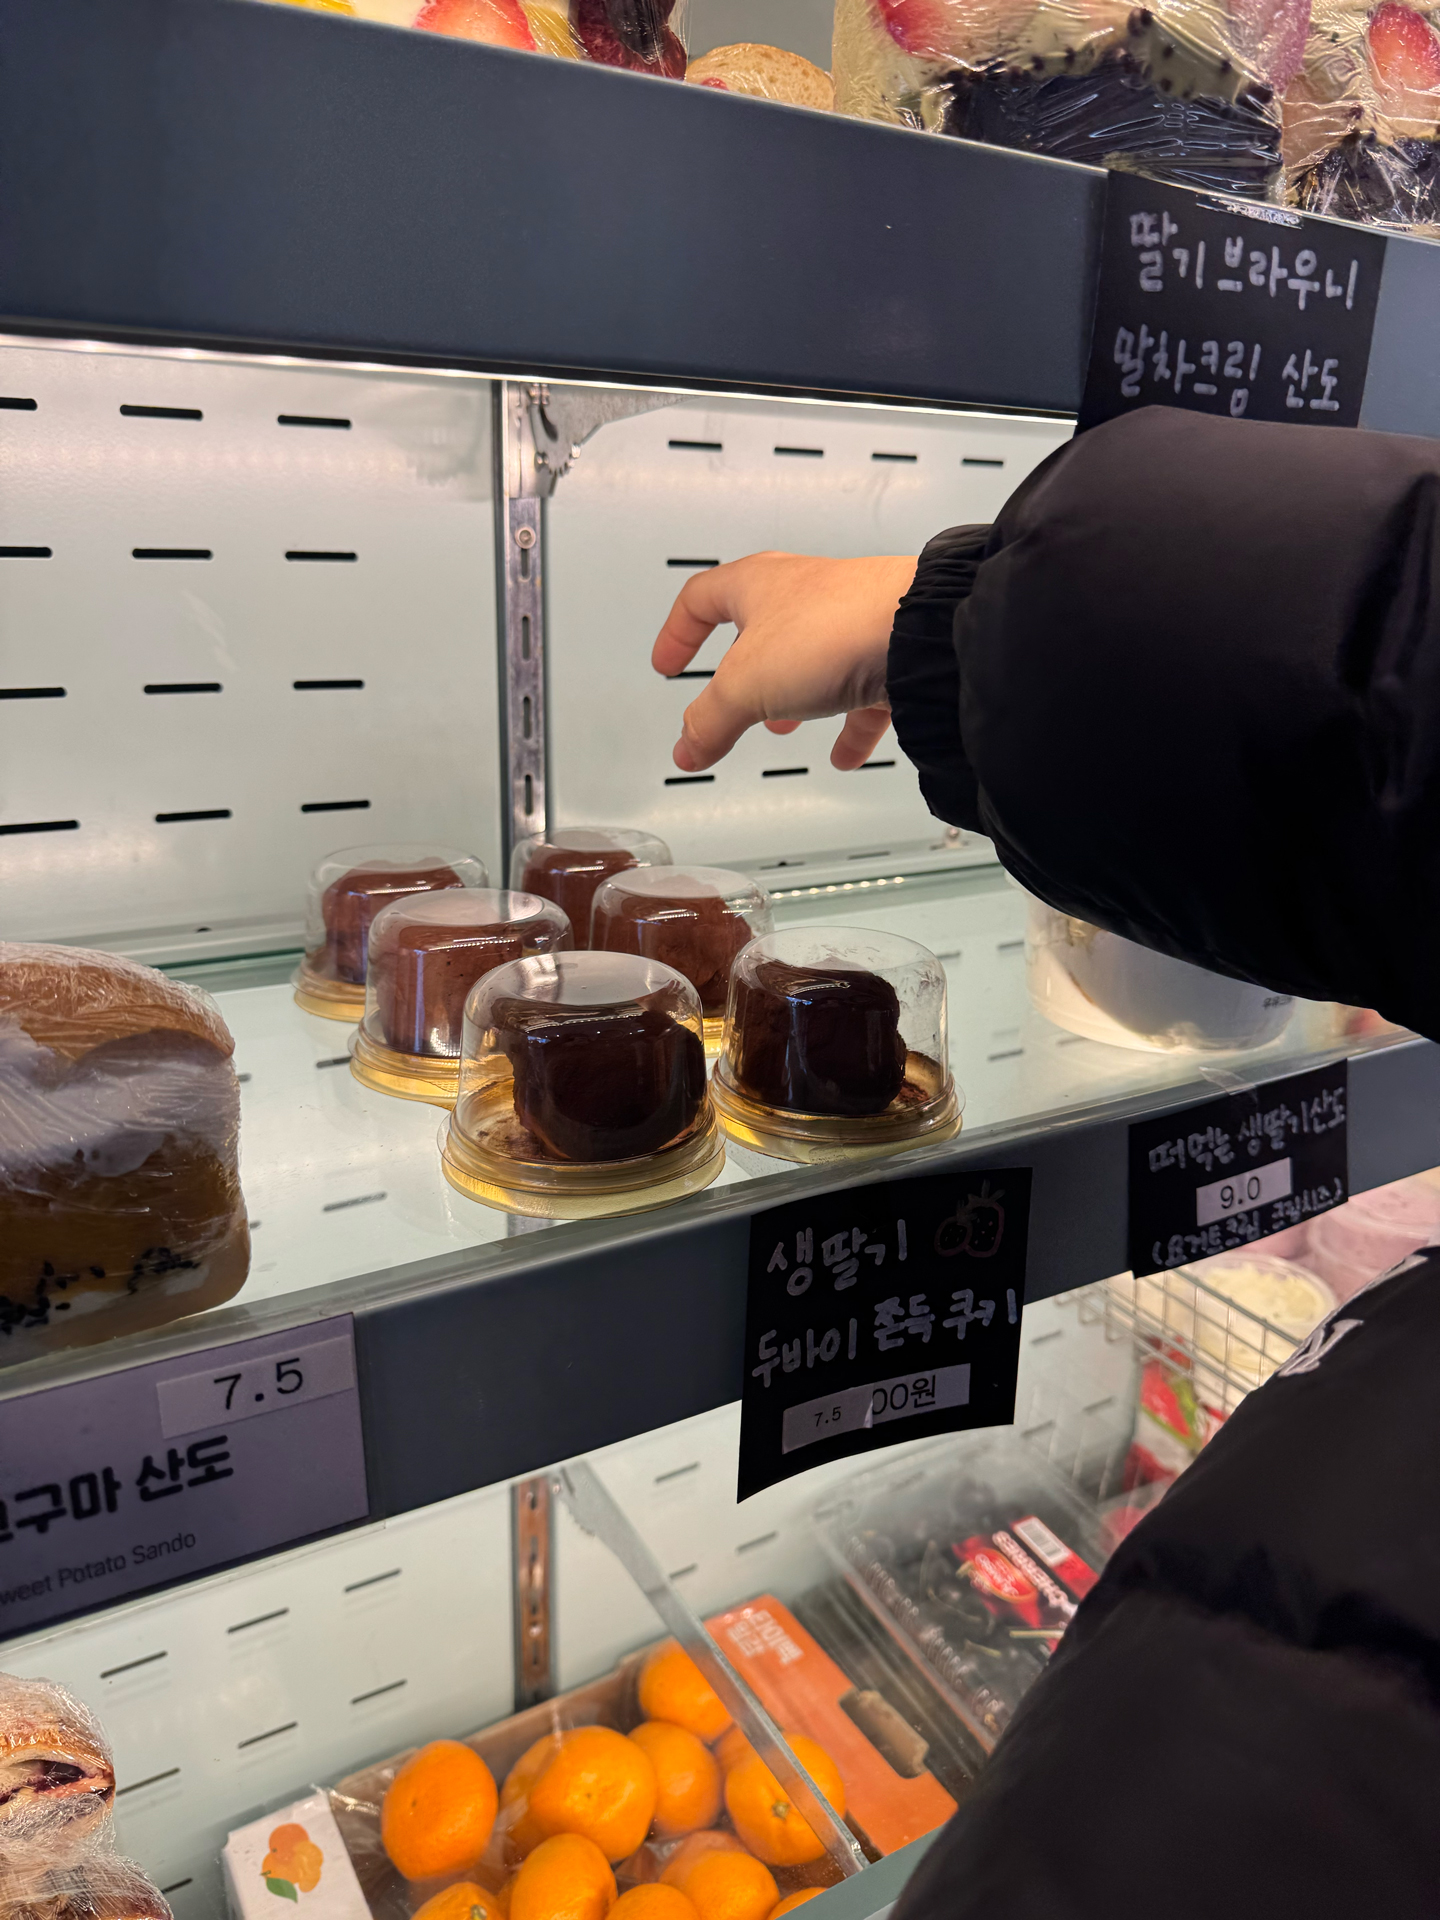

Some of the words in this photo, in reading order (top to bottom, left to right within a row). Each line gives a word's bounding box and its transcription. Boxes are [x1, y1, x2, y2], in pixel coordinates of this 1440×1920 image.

[1130, 211, 1206, 291] 딸기
[1217, 236, 1358, 310] 브라우니
[1114, 324, 1261, 417] 말차크림
[1282, 349, 1340, 411] 산도
[1149, 1126, 1234, 1172] 떠먹는
[1220, 1176, 1260, 1209] 9.0
[767, 1218, 907, 1296] 생딸기
[213, 1357, 304, 1410] 7.5
[752, 1318, 857, 1388] 두바이
[814, 1406, 842, 1427] 7.5
[0, 1466, 122, 1543] 구마
[135, 1434, 234, 1502] 산도
[0, 1574, 53, 1605] weet
[58, 1552, 127, 1589] Potato
[132, 1530, 197, 1565] Sando
